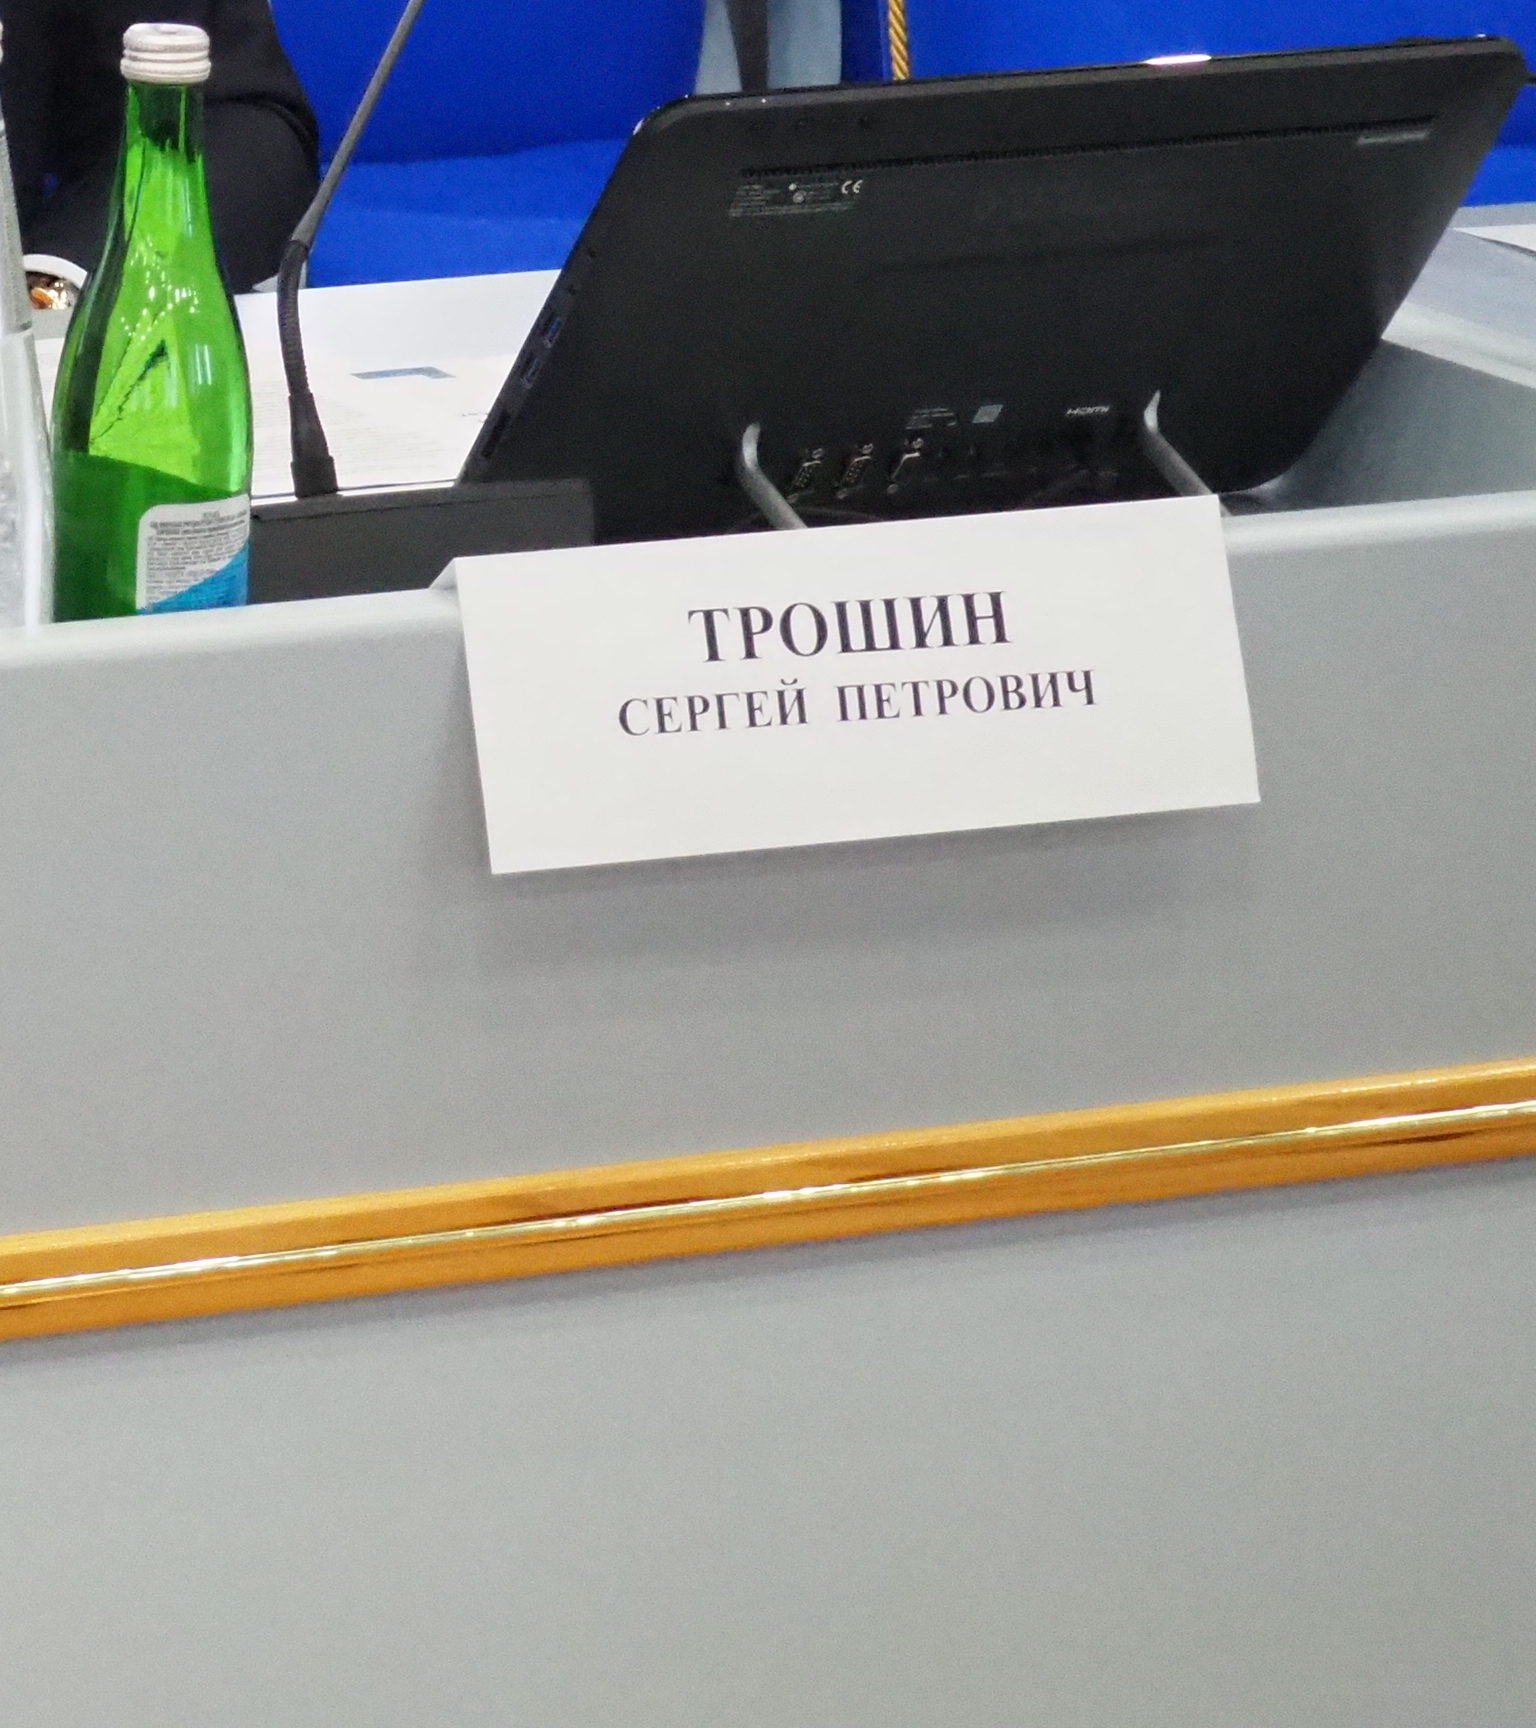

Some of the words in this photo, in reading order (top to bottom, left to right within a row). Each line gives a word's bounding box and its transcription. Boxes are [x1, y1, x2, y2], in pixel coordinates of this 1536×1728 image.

[687, 590, 1013, 663] ТРОШИН
[617, 678, 809, 738] СЕРГЕЙ
[835, 669, 1099, 724] ПЕТРОВИЧ
